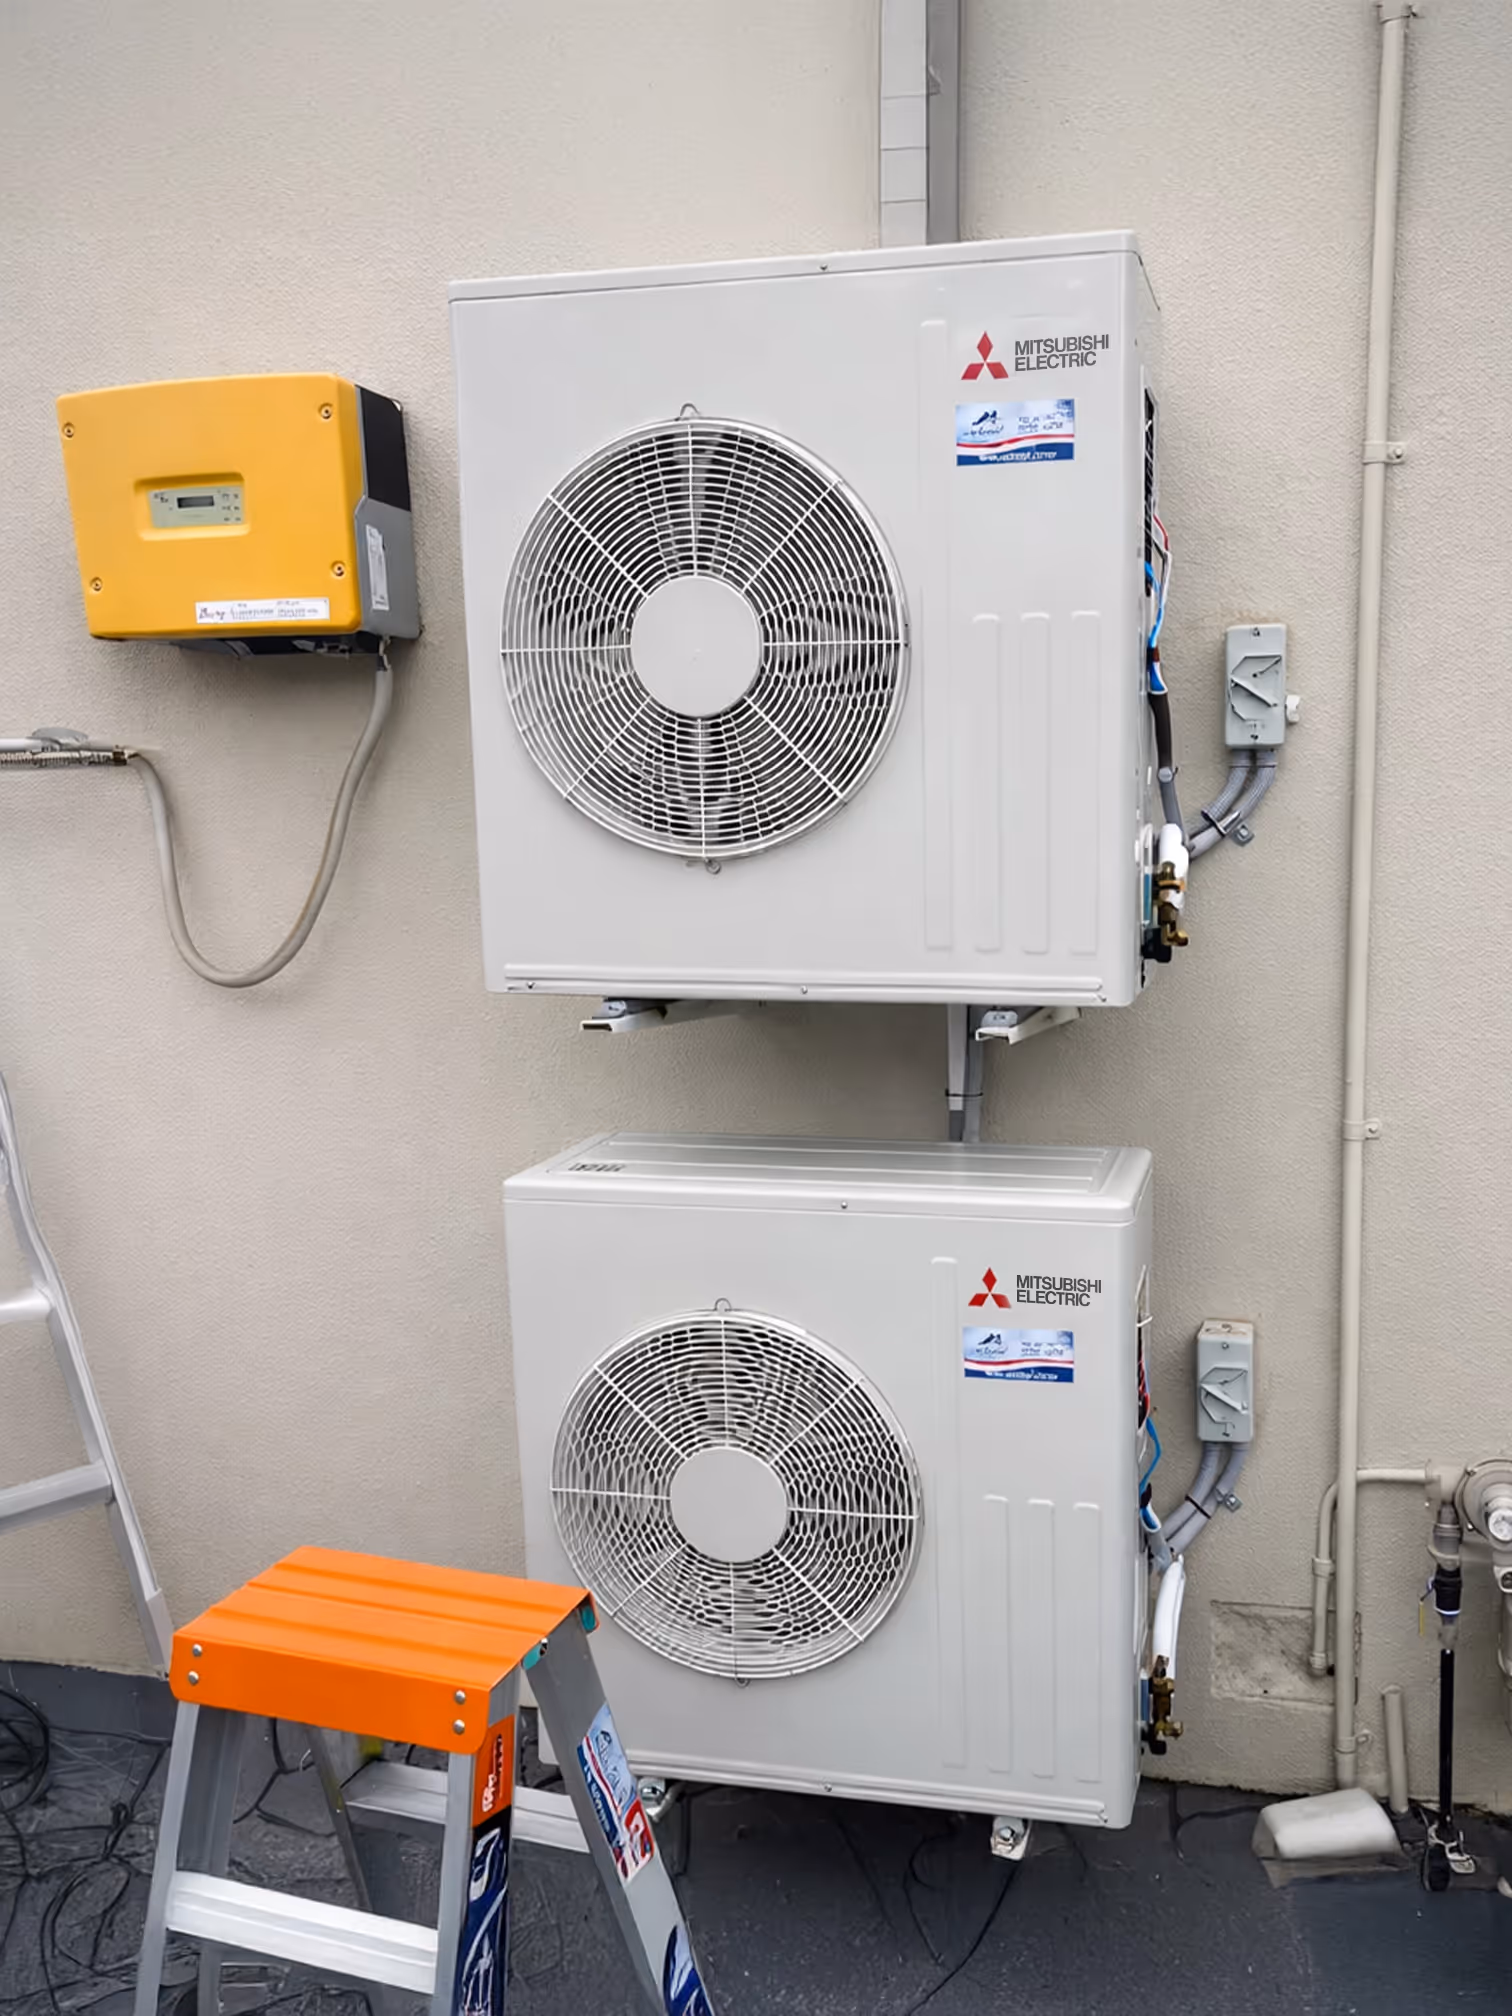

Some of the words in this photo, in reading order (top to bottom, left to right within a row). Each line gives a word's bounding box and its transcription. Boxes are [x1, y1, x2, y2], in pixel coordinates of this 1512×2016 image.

[1014, 333, 1109, 356] MITSUBISHI
[1014, 351, 1097, 372] ELECTRIC
[1016, 1274, 1102, 1294] MITSUBISHI
[1016, 1289, 1091, 1307] ELECTRIC
